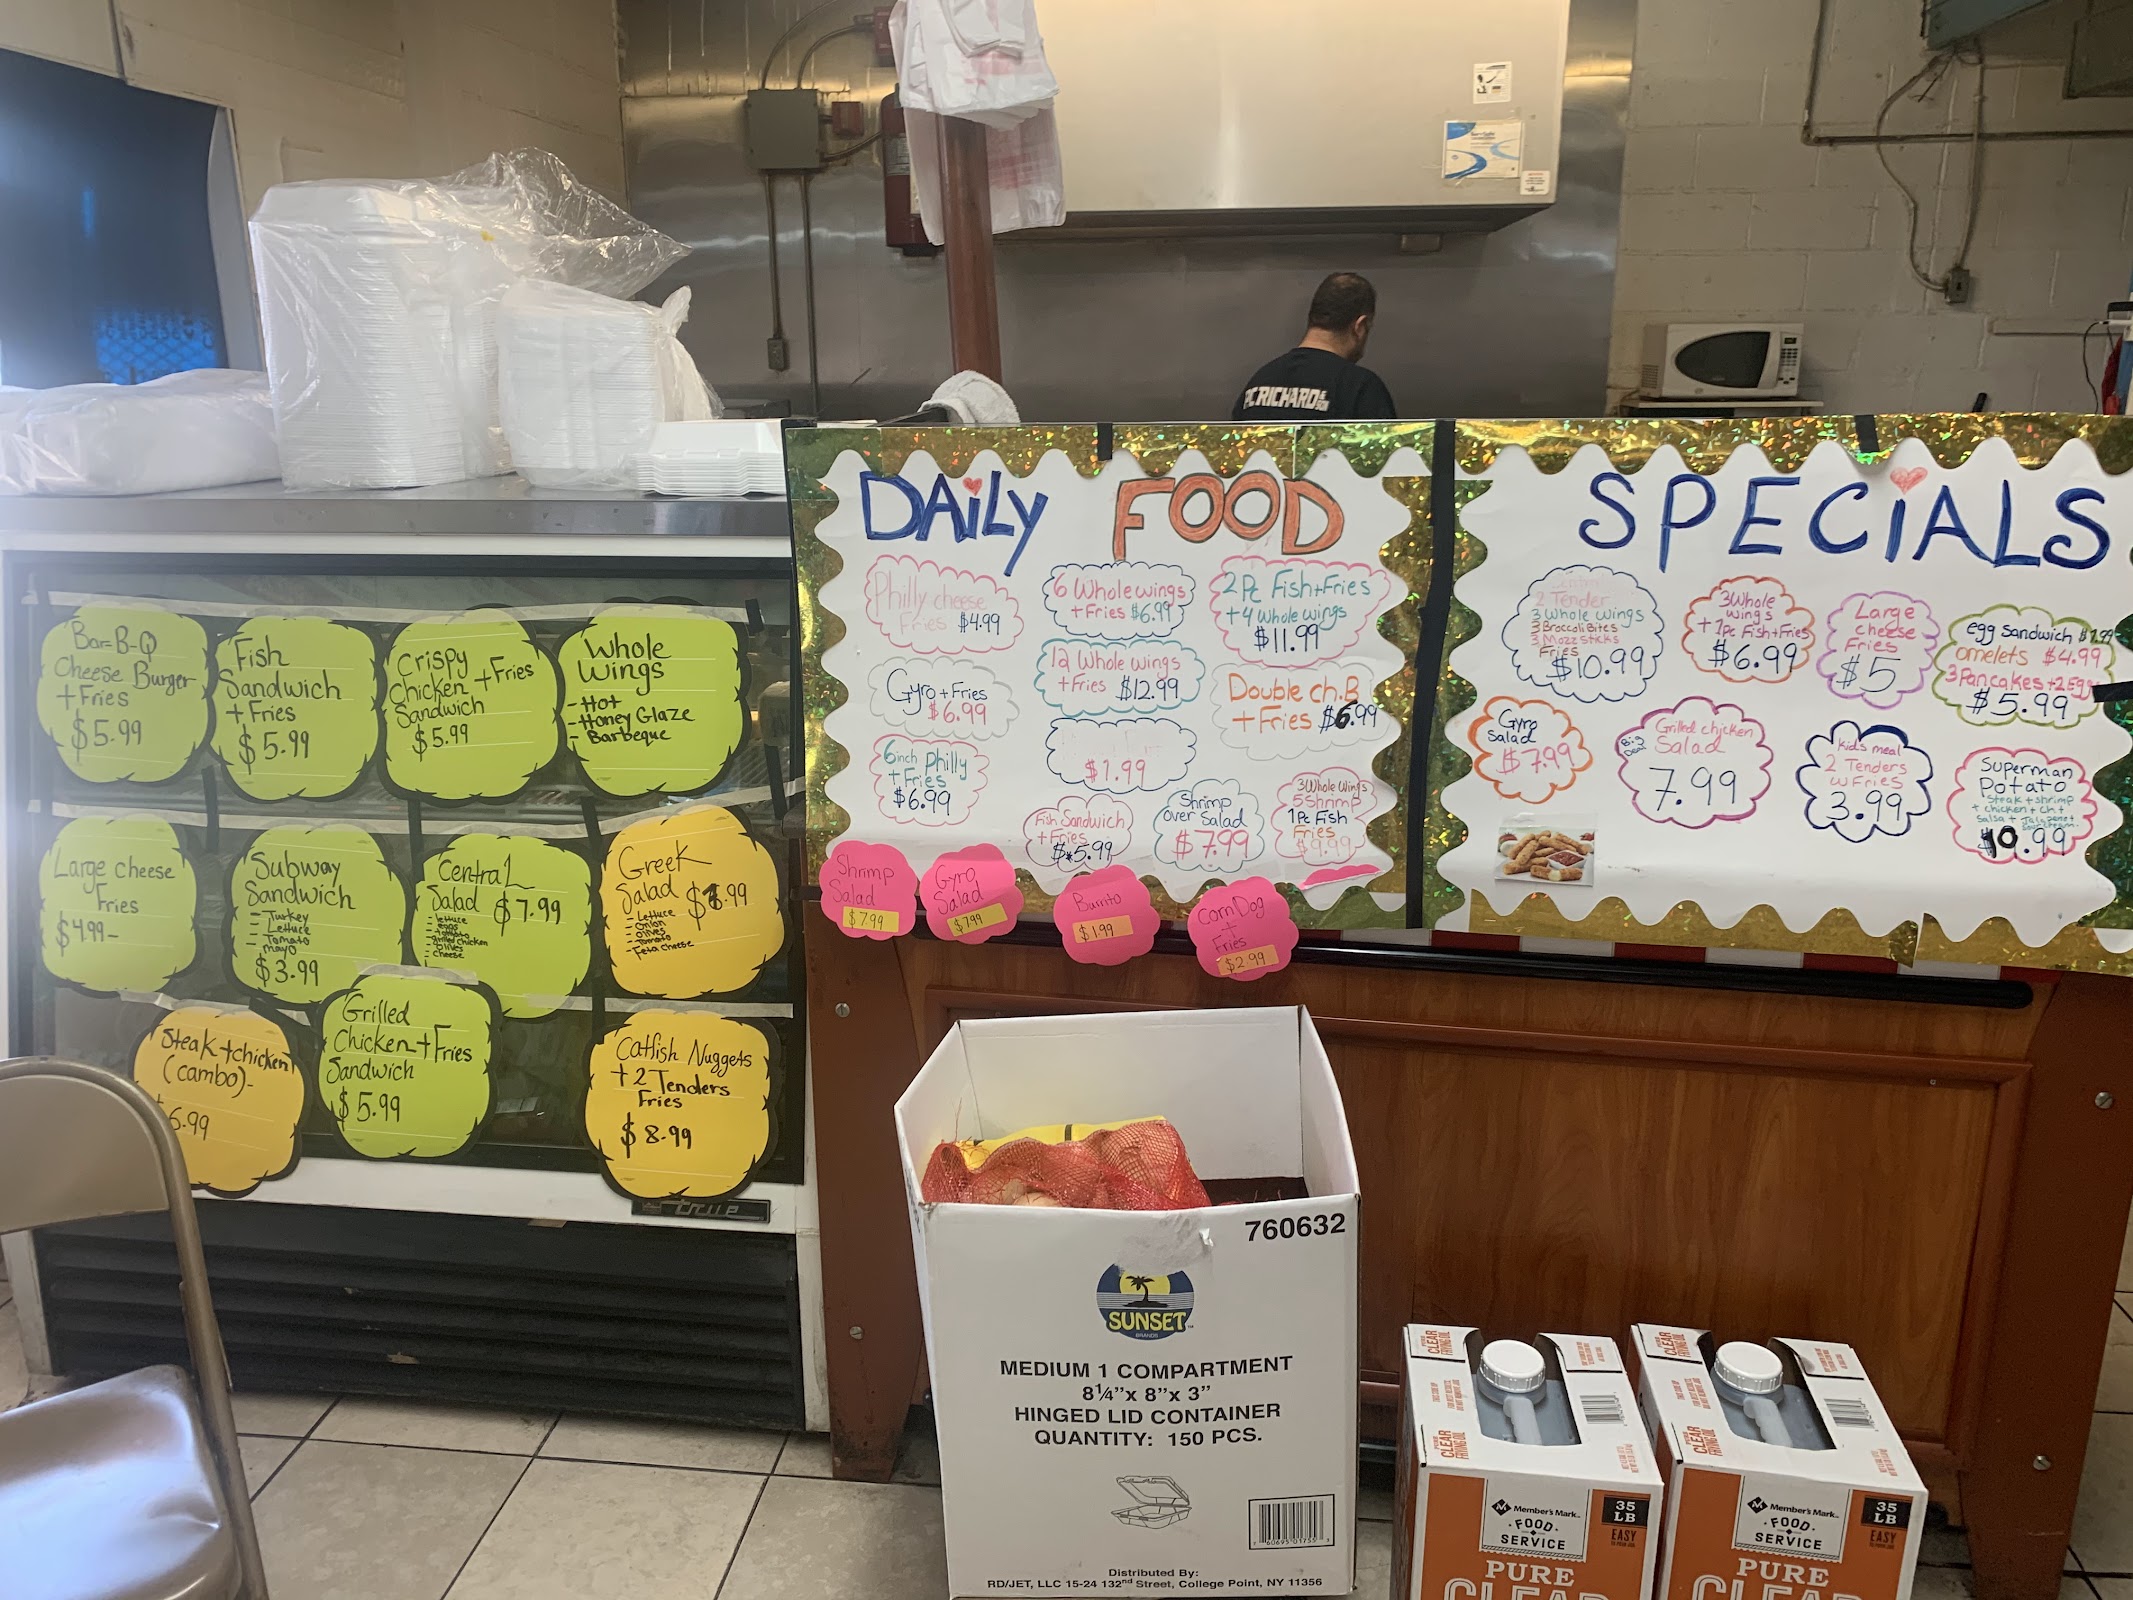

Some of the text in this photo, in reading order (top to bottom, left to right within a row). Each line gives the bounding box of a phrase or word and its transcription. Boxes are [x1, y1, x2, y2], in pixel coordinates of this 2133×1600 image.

[1256, 386, 1320, 409] RICHARD
[1112, 470, 1345, 562] FOOD
[958, 611, 1000, 635] $4.99
[1130, 602, 1171, 623] $6.99
[1855, 600, 1914, 630] Large
[584, 632, 672, 661] Whole
[1254, 625, 1319, 653] $11.99
[1844, 638, 1898, 653] Fries
[234, 635, 290, 671] Fish
[397, 648, 468, 679] Crispy
[1076, 646, 1127, 672] Whole
[1539, 646, 1579, 658] Fries
[1547, 646, 1645, 682] $10.99
[1708, 638, 1797, 674] $6.99
[2042, 648, 2101, 667] $4.99
[54, 655, 197, 695] Cheese Burger
[218, 669, 342, 700] Sandwich
[578, 661, 665, 696] Wings
[390, 680, 469, 706] Chicken
[1116, 678, 1178, 702] $12.99
[1228, 674, 1302, 702] Double
[395, 697, 485, 729] Sandwich
[636, 706, 695, 724] Glaze
[927, 702, 986, 724] $6.99
[1966, 686, 2068, 720] $5.99
[1498, 708, 1538, 737] Gyro
[1655, 717, 1697, 735] Grilled
[1655, 736, 1725, 755] Salad
[1872, 743, 1901, 756] meal
[1496, 742, 1575, 775] $7.99
[1824, 755, 1907, 775] 2 Tenders
[1981, 757, 2073, 780] Superman
[1084, 759, 1146, 786] $1.99
[1649, 766, 1736, 811] 7.99
[893, 786, 950, 816] $6.99
[1180, 794, 1231, 809] Shrimp
[1826, 790, 1902, 822] 3.99
[1035, 810, 1125, 830] Fish Sandwich
[1201, 807, 1247, 827] Salad
[1315, 810, 1348, 824] Fish
[1293, 826, 1335, 838] Fries
[53, 847, 106, 894] Large
[250, 850, 341, 887] Subway
[618, 840, 712, 880] Greek
[837, 854, 895, 881] Shrimp
[935, 867, 975, 894] Gyro
[96, 882, 139, 915] Fries
[244, 877, 356, 910] Sandwich
[616, 874, 679, 914] Salad
[830, 879, 875, 907] Salad
[934, 886, 984, 916] Salad
[1073, 892, 1122, 913] Burrito
[262, 908, 309, 927] Turkey
[427, 884, 561, 936] Salad $7.99
[268, 918, 311, 935] Lettuce
[263, 934, 309, 945] Tomato
[1213, 936, 1247, 952] Fries
[256, 953, 318, 987] $3.99
[1224, 951, 1266, 973] $2.99
[342, 993, 410, 1025] Grilled
[161, 1028, 216, 1060] Steak
[616, 1032, 752, 1077] Catfish Nuggets
[326, 1056, 414, 1084] Sandwich
[647, 1069, 731, 1097] Tenders
[638, 1090, 683, 1109] Fries
[1245, 1213, 1346, 1242] 760632
[1107, 1310, 1187, 1332] SUNSET
[1000, 1356, 1292, 1379] MEDIUM 1 COMPARTMENT
[1014, 1403, 1281, 1425] HINGED LID CONTAINER
[1034, 1428, 1262, 1447] QUANTITY: 150 PCS.
[1514, 1505, 1553, 1516] Member's
[1616, 1500, 1636, 1510] 35
[1770, 1503, 1812, 1515] Member's
[1876, 1502, 1897, 1512] 35
[1515, 1519, 1554, 1532] FOOD
[1613, 1512, 1636, 1523] LB
[1771, 1517, 1811, 1531] FOOD
[1873, 1513, 1897, 1525] LB
[1501, 1534, 1565, 1550] SERVICE
[1612, 1529, 1637, 1541] EASY
[1755, 1532, 1822, 1550] SERVICE
[1870, 1530, 1896, 1543] EASY
[988, 1579, 1034, 1589] RD/JET,
[1037, 1579, 1061, 1588] LLC
[1065, 1579, 1097, 1588] 15-24
[1136, 1579, 1175, 1589] Street,
[1179, 1579, 1224, 1589] College
[1227, 1578, 1263, 1589] Point,
[1267, 1578, 1284, 1587] NY
[1288, 1578, 1322, 1587] 11356
[1109, 1569, 1199, 1578] Distributed By:
[1485, 1560, 1574, 1586] PURE
[1737, 1558, 1829, 1587] PURE
